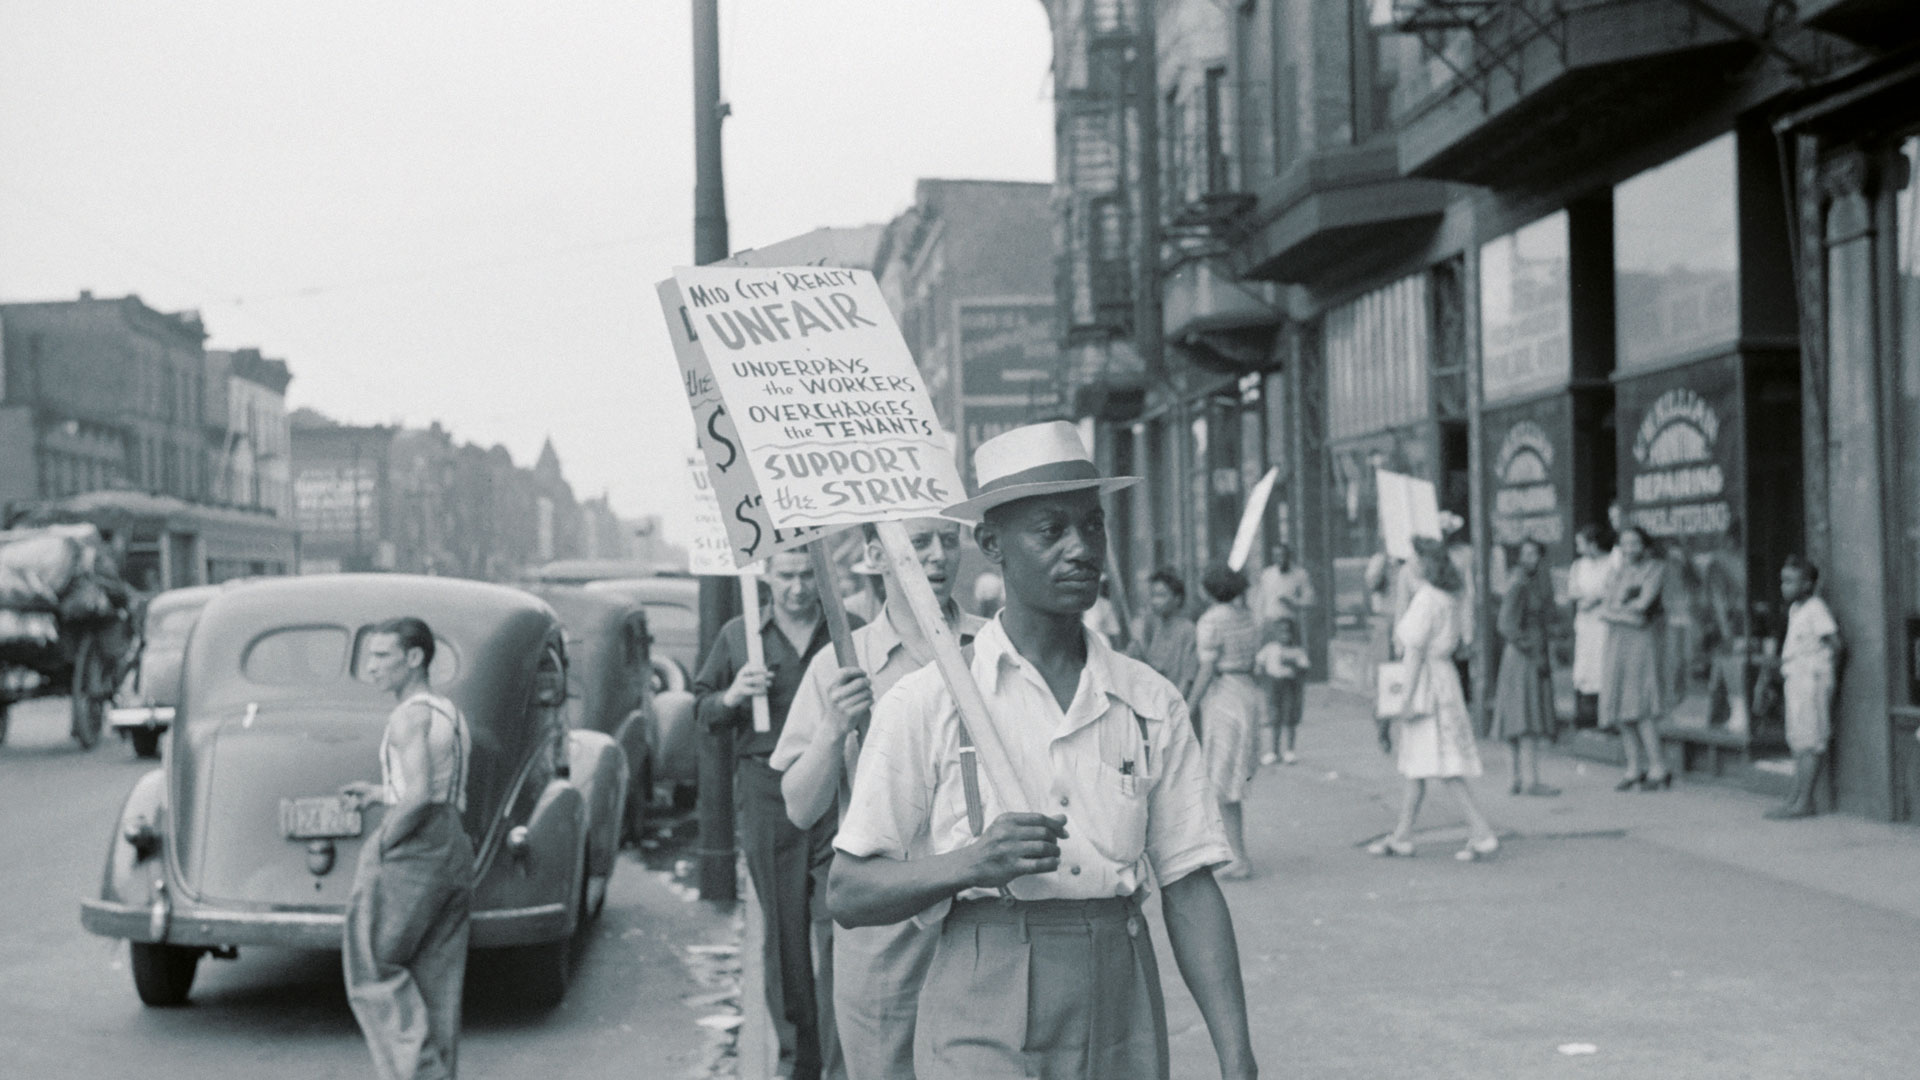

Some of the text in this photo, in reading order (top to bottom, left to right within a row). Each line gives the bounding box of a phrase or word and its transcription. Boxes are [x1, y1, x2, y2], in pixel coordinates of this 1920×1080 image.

[689, 270, 858, 308] MID CITY REALTY
[706, 292, 878, 350] UNFAIR
[732, 357, 869, 378] UNDERPAYS
[762, 376, 915, 396] the WORKERS
[748, 400, 914, 423] OVERCHARGES
[784, 417, 933, 440] the TENANTS
[764, 446, 922, 480] SUPPORT
[774, 476, 949, 510] the STRIKE
